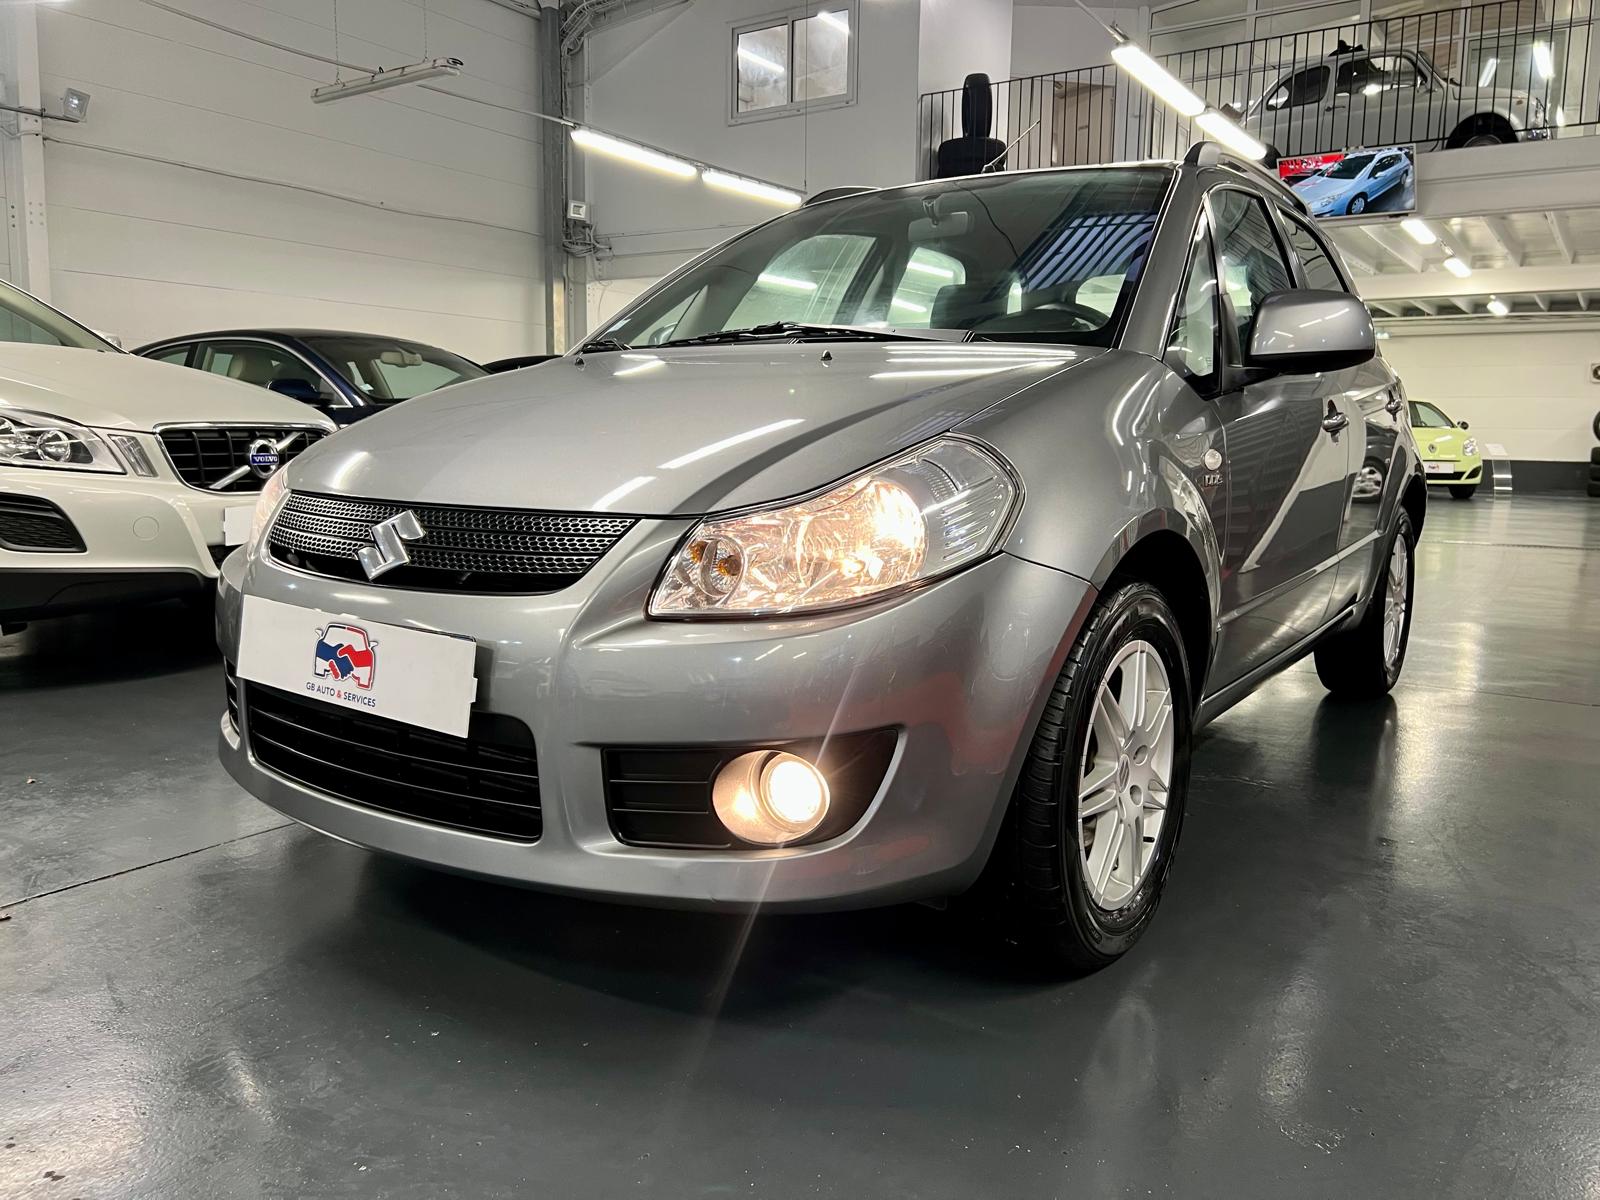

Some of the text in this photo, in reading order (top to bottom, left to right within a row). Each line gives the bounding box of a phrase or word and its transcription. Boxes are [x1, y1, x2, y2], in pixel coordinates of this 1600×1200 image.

[306, 682, 376, 708] GB AUTO & SERVICES
